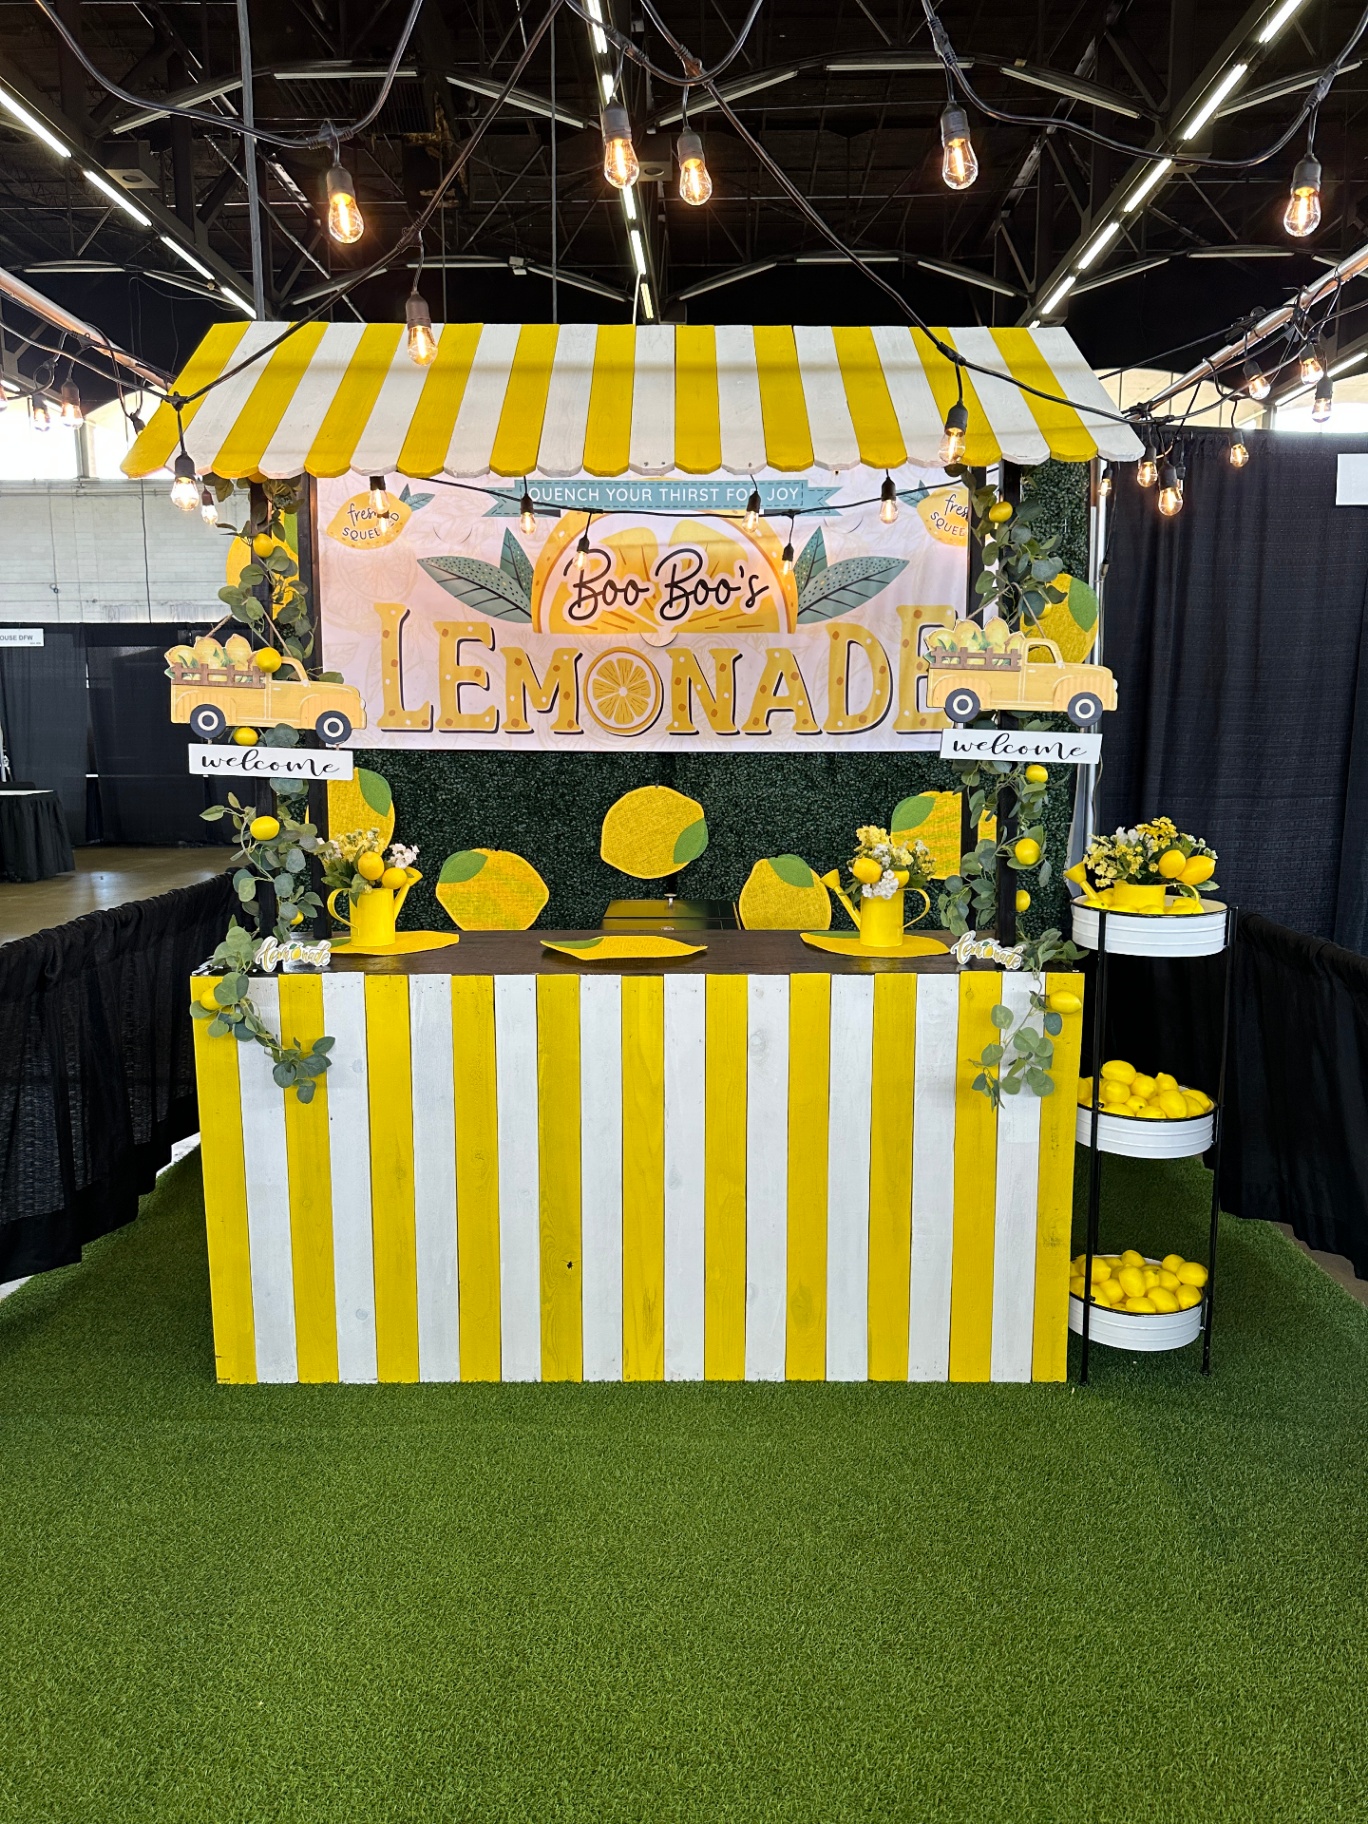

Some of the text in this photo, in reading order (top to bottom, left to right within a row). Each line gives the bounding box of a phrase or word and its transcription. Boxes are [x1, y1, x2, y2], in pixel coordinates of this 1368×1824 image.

[529, 486, 799, 502] QUENCH YOUR THIRST FO JOY
[945, 494, 968, 520] fres
[342, 512, 400, 542] SQUED
[931, 512, 966, 536] SQUEE
[563, 547, 770, 621] Boo Boo's
[373, 602, 957, 736] LEMONADE
[953, 732, 1088, 760] welcome
[202, 749, 340, 777] welcome
[255, 936, 331, 972] lemonade
[950, 930, 1026, 970] lemonade
